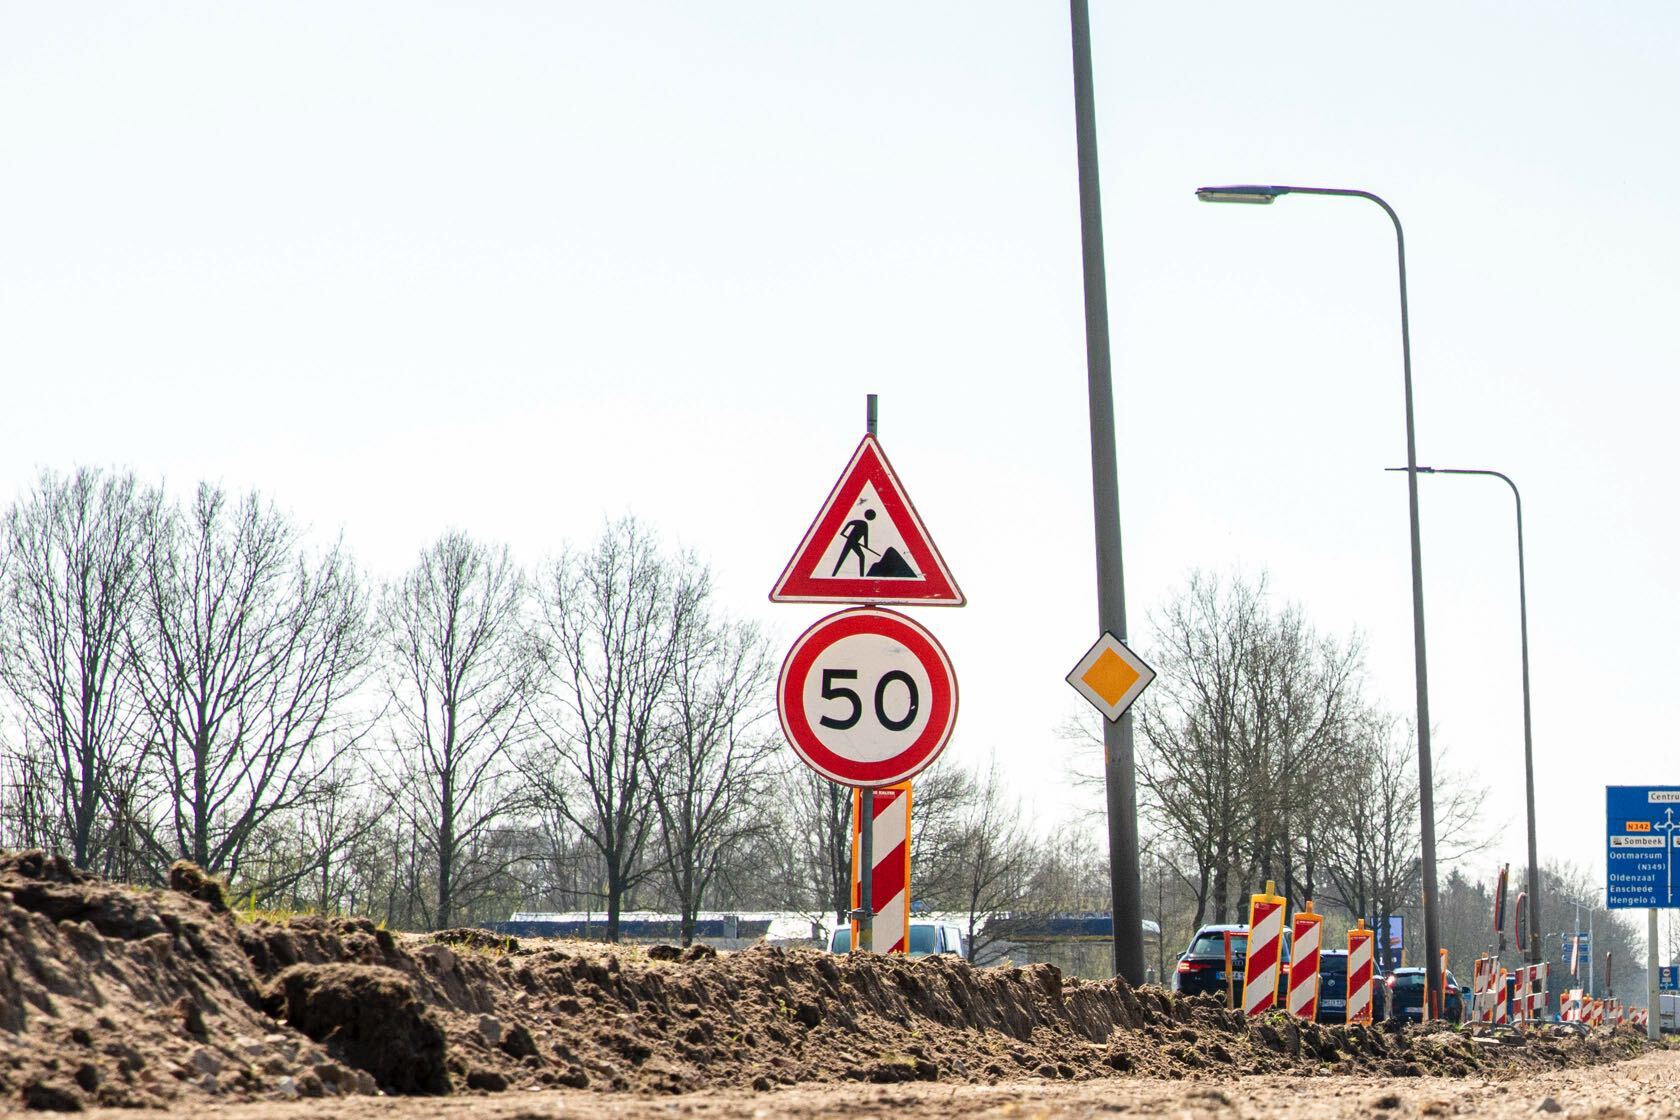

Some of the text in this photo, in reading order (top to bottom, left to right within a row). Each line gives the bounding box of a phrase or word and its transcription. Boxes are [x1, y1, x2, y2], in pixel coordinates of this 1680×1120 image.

[819, 668, 920, 732] 50
[1624, 837, 1663, 845] Sombeek
[1610, 852, 1663, 860] Ootmarsum
[1637, 863, 1666, 871] (N349)
[1610, 874, 1655, 882] Oldenzaal
[1610, 885, 1653, 893] Enschede
[1610, 896, 1648, 905] Hengelo
